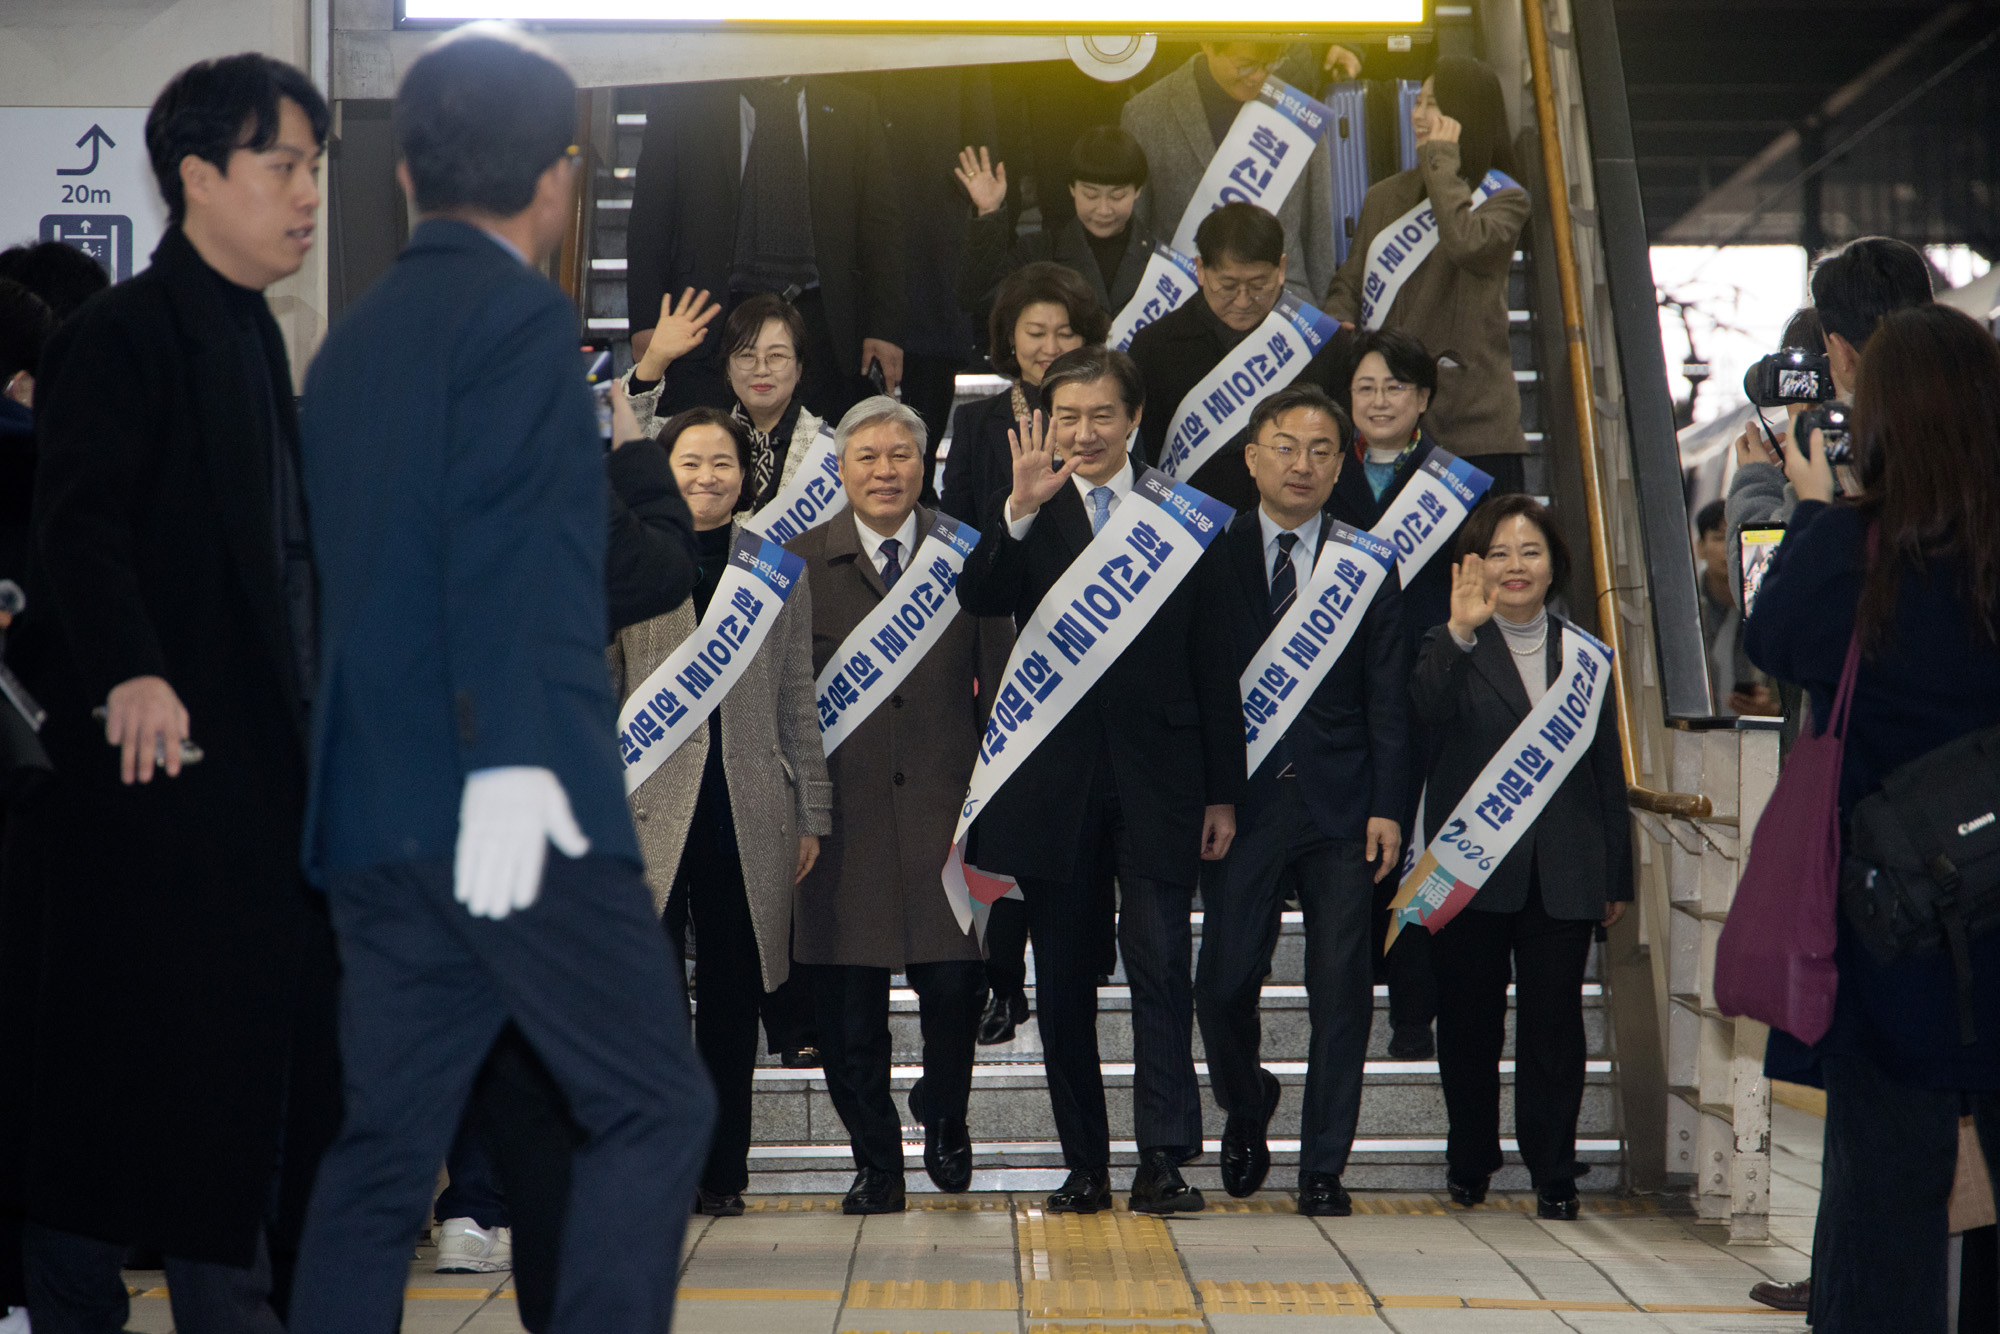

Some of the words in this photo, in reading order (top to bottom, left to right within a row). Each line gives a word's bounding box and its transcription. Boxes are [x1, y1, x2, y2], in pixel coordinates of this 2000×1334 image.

[1260, 82, 1322, 129] 조국혁신당
[61, 184, 111, 204] 20m
[1280, 303, 1322, 346] 조국혁신당
[1202, 331, 1295, 425] 혁신으로
[764, 451, 844, 546] 혁신으로
[1145, 478, 1214, 533] 조국혁신당
[1428, 459, 1475, 501] 조국혁신당
[737, 549, 790, 589] 조국혁신당
[1336, 528, 1392, 559] 조국혁신당
[869, 556, 958, 664] 혁신으로
[1046, 520, 1175, 666] 혁신으로
[1281, 557, 1368, 671] 혁신으로
[675, 585, 764, 700] 혁신으로
[979, 650, 1064, 766] 희망찬
[1539, 647, 1599, 753] 혁신으로
[1475, 743, 1554, 831] 희망찬
[1440, 817, 1498, 871] 2026
[1958, 812, 1996, 836] Canon
[1417, 870, 1455, 910] 福
